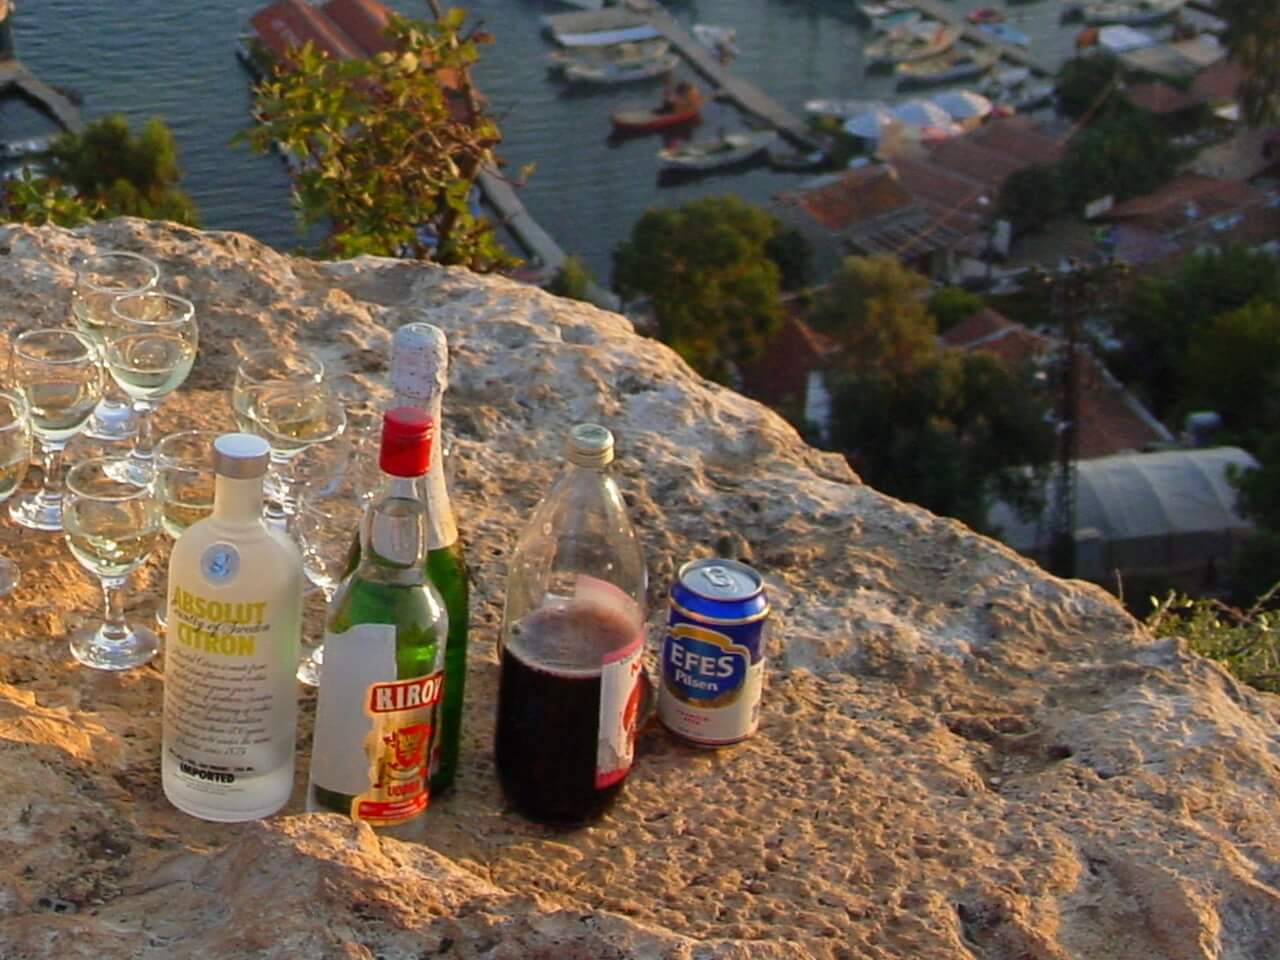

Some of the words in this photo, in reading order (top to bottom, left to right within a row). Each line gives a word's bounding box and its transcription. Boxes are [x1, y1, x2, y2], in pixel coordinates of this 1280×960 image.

[172, 586, 266, 625] ABSOLUT
[176, 622, 256, 656] CITRON
[670, 642, 735, 677] EFES
[674, 668, 719, 692] Pilsen
[180, 761, 235, 783] IMPORTED
